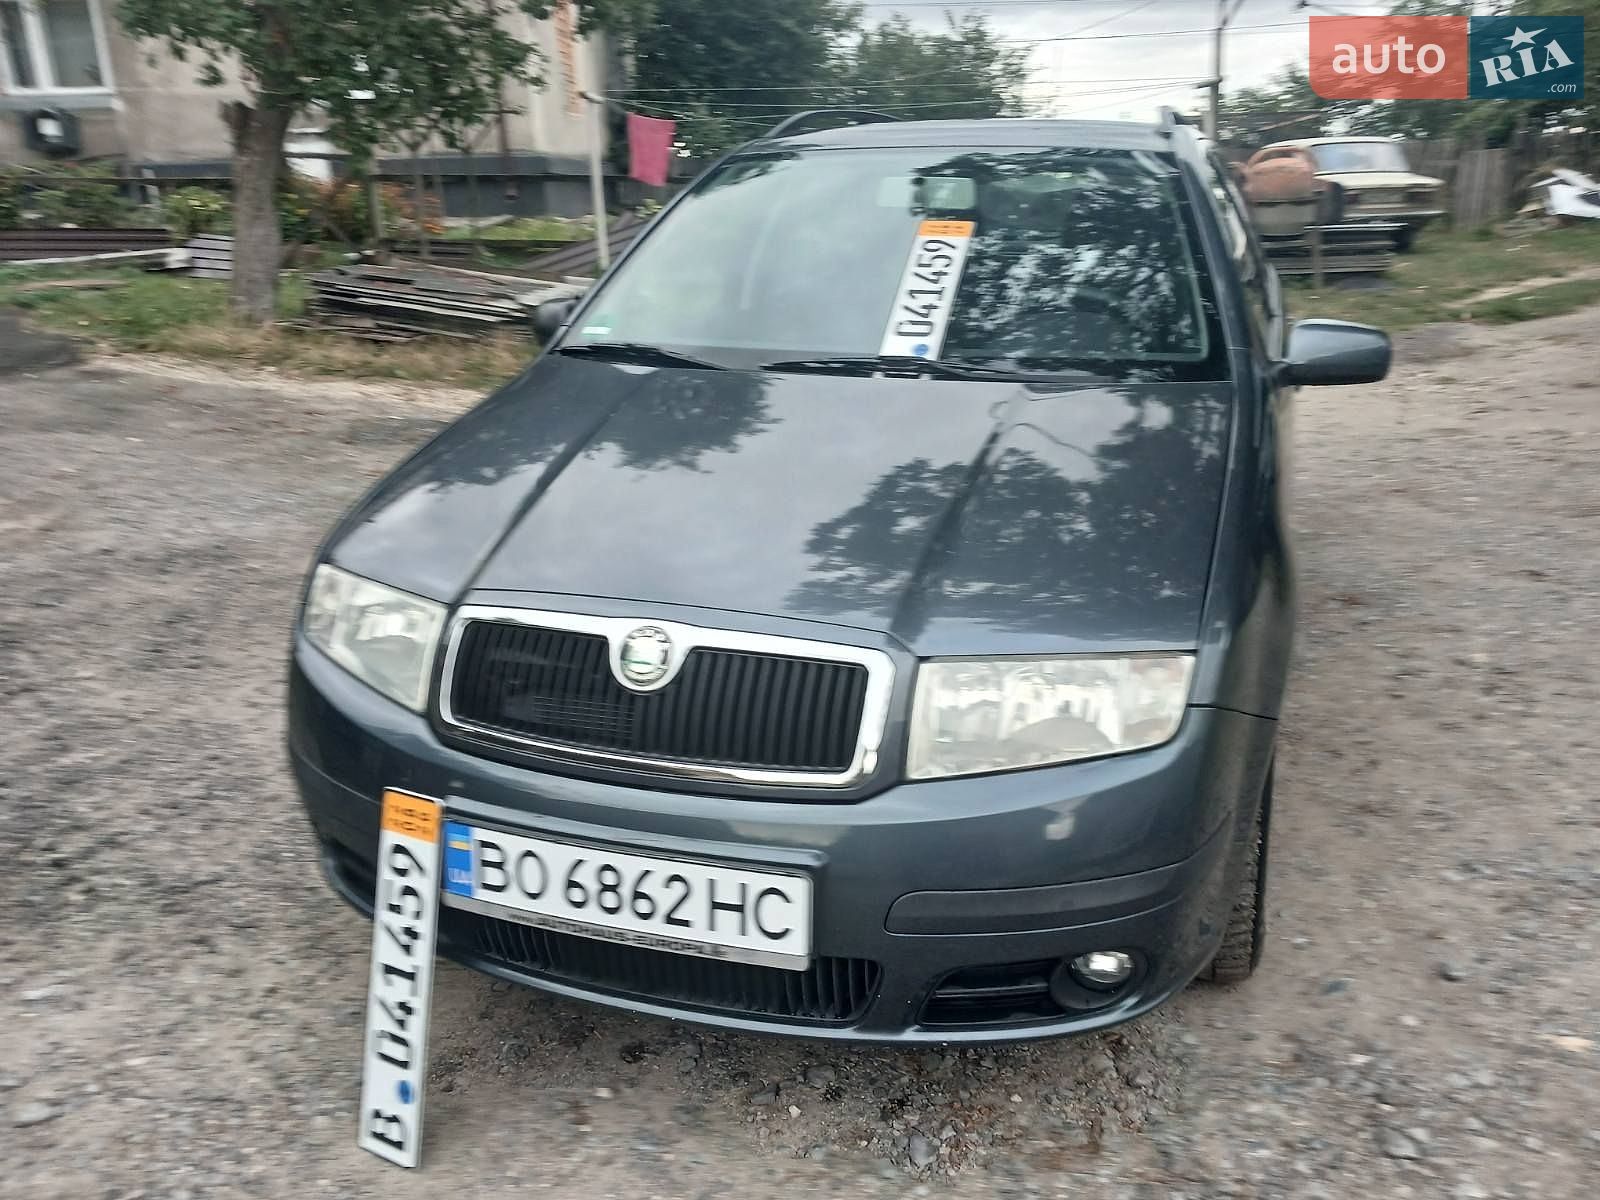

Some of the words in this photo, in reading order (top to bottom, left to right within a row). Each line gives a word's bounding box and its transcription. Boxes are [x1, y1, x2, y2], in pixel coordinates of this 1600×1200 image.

[895, 239, 957, 337] 041459
[473, 839, 548, 900] BO
[563, 858, 695, 928] 6862
[706, 877, 794, 941] HC
[372, 842, 426, 1071] 041459
